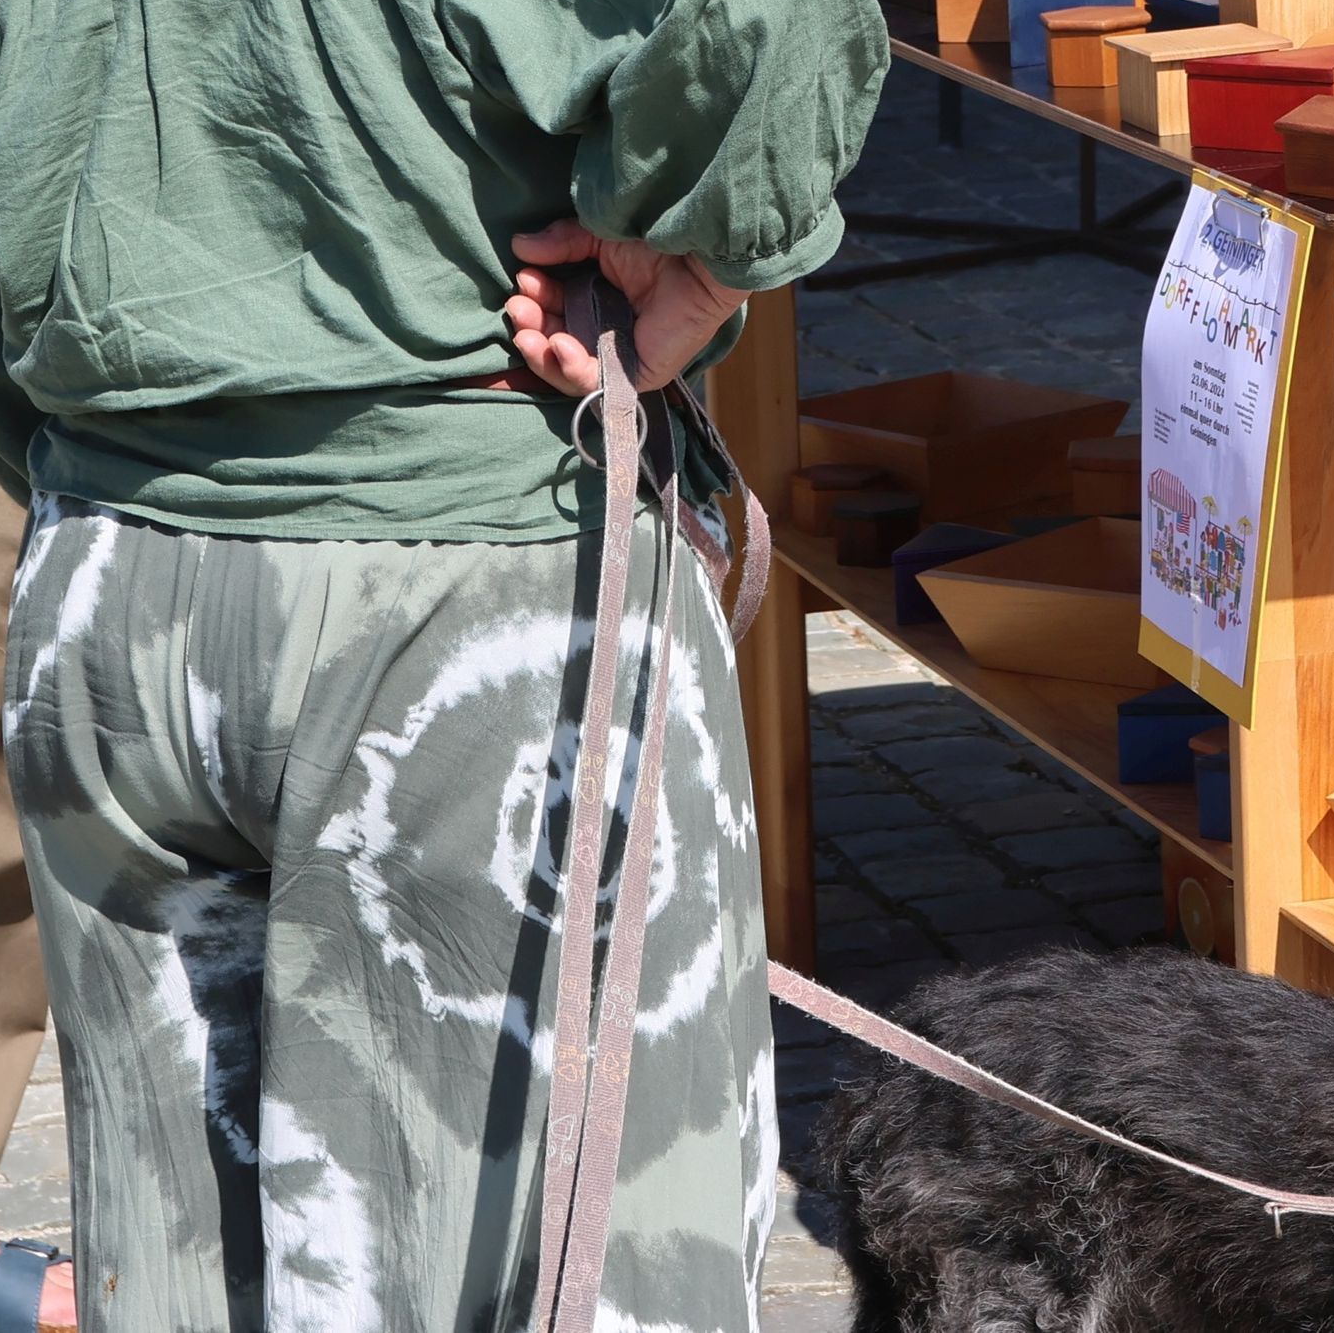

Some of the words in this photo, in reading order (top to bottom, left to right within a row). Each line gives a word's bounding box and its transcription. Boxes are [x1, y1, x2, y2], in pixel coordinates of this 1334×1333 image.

[1213, 229, 1266, 272] GEININGER
[1193, 360, 1202, 370] am
[1204, 362, 1226, 384] Sonntag
[1191, 373, 1225, 398] 23.06.2024
[1190, 390, 1197, 402] 11
[1204, 397, 1212, 410] 16
[1213, 401, 1223, 415] Uhr
[1180, 403, 1199, 420] einmal
[1200, 414, 1213, 426] quer
[1213, 419, 1229, 436] durch
[1190, 424, 1217, 447] Geiningen
